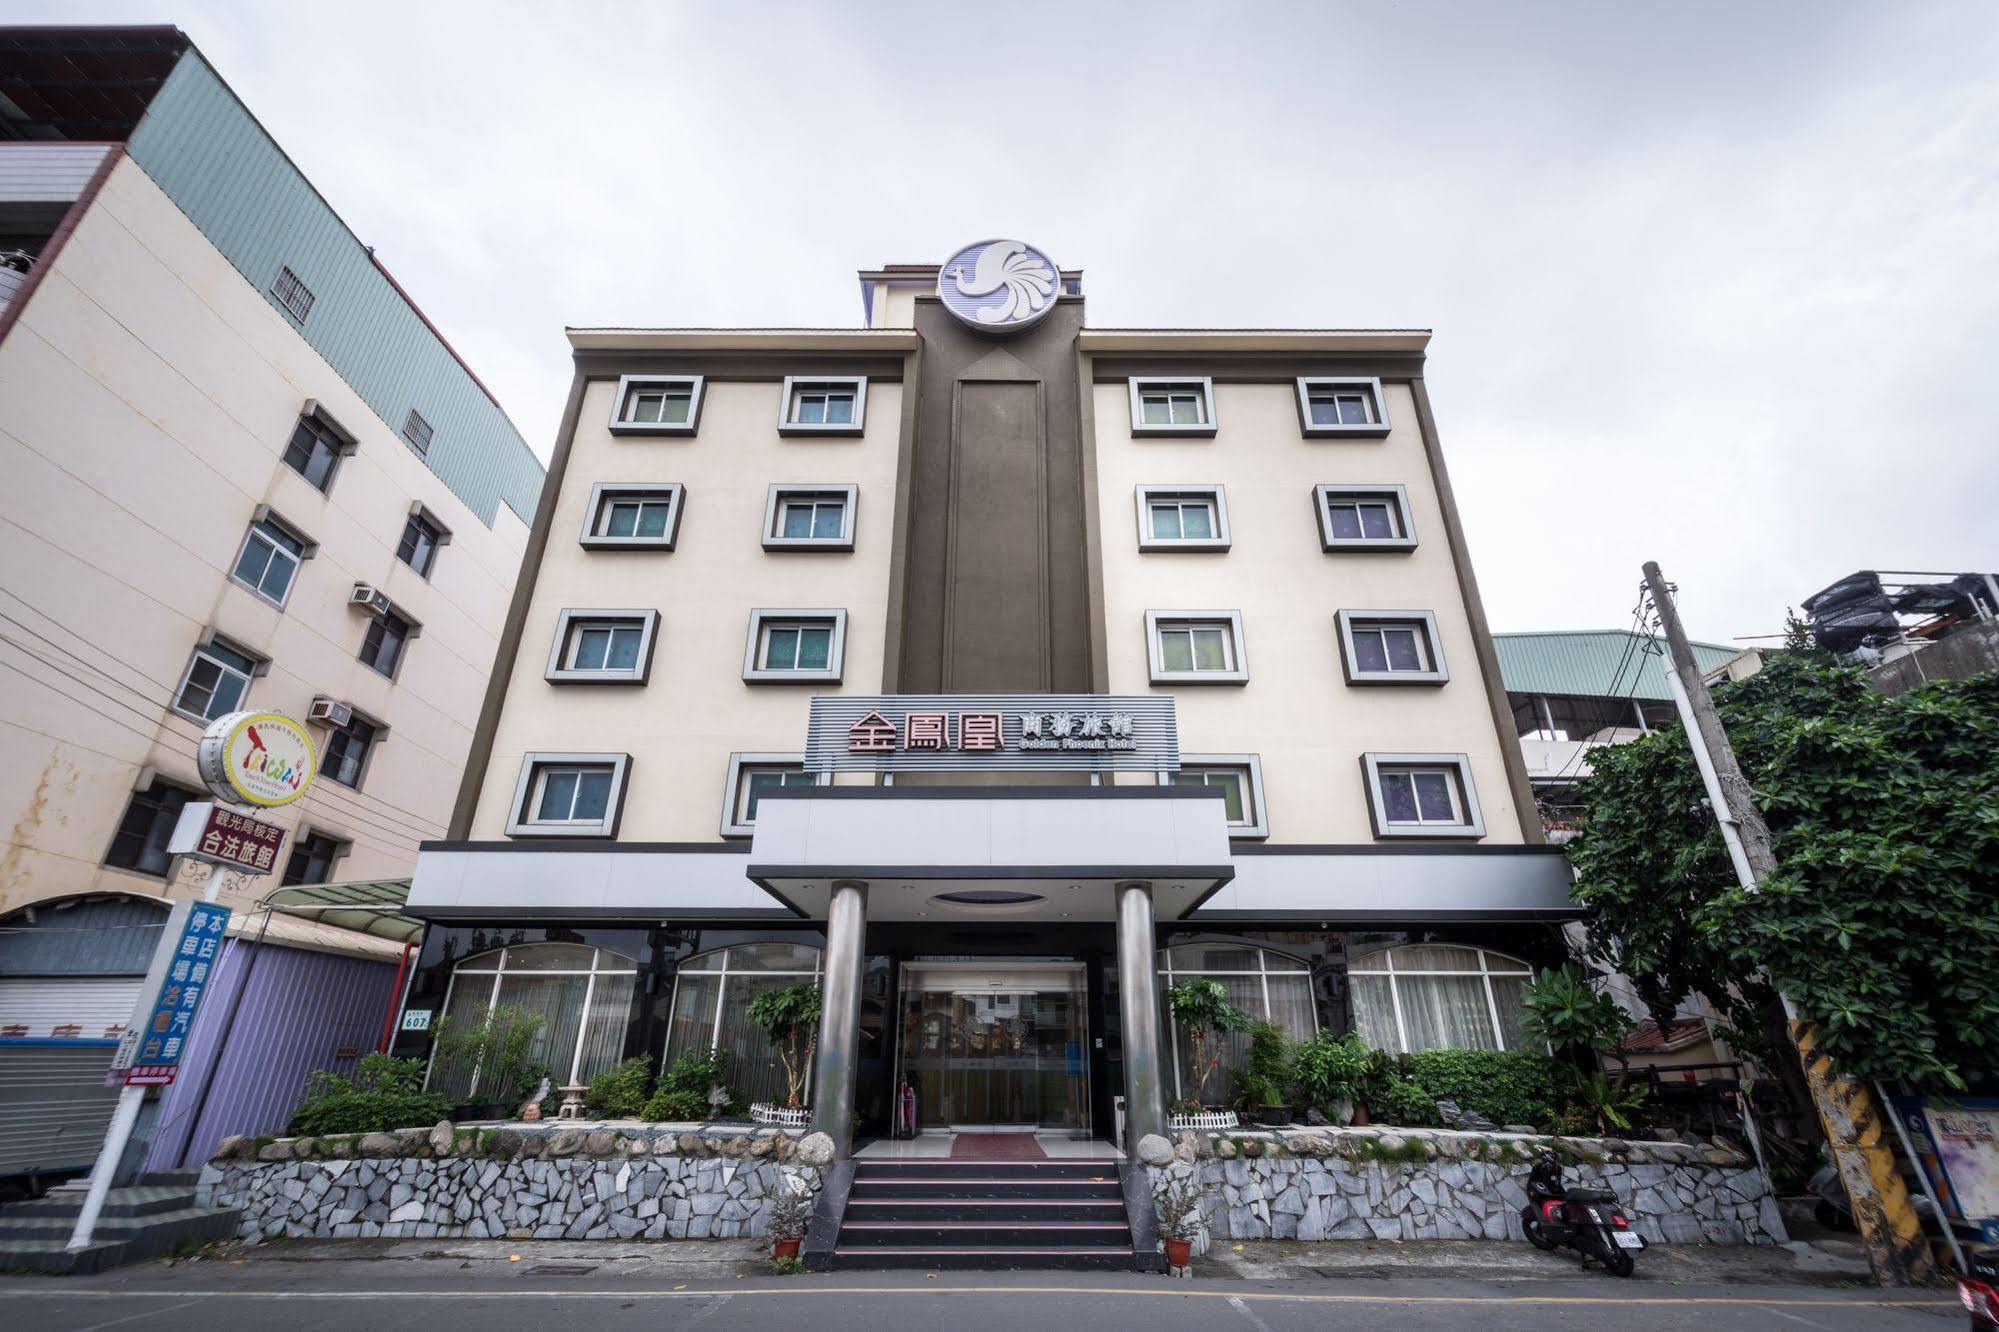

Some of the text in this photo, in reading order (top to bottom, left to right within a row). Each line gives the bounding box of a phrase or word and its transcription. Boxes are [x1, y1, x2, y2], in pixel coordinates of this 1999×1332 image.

[848, 708, 1005, 752] 金鳳凰
[1019, 710, 1136, 737] 商務旅館
[1018, 738, 1137, 749] Golden Phoenix Hotel
[216, 809, 279, 843] 觀光局核定
[202, 830, 275, 869] 合法旅館
[406, 1017, 427, 1028] 607
